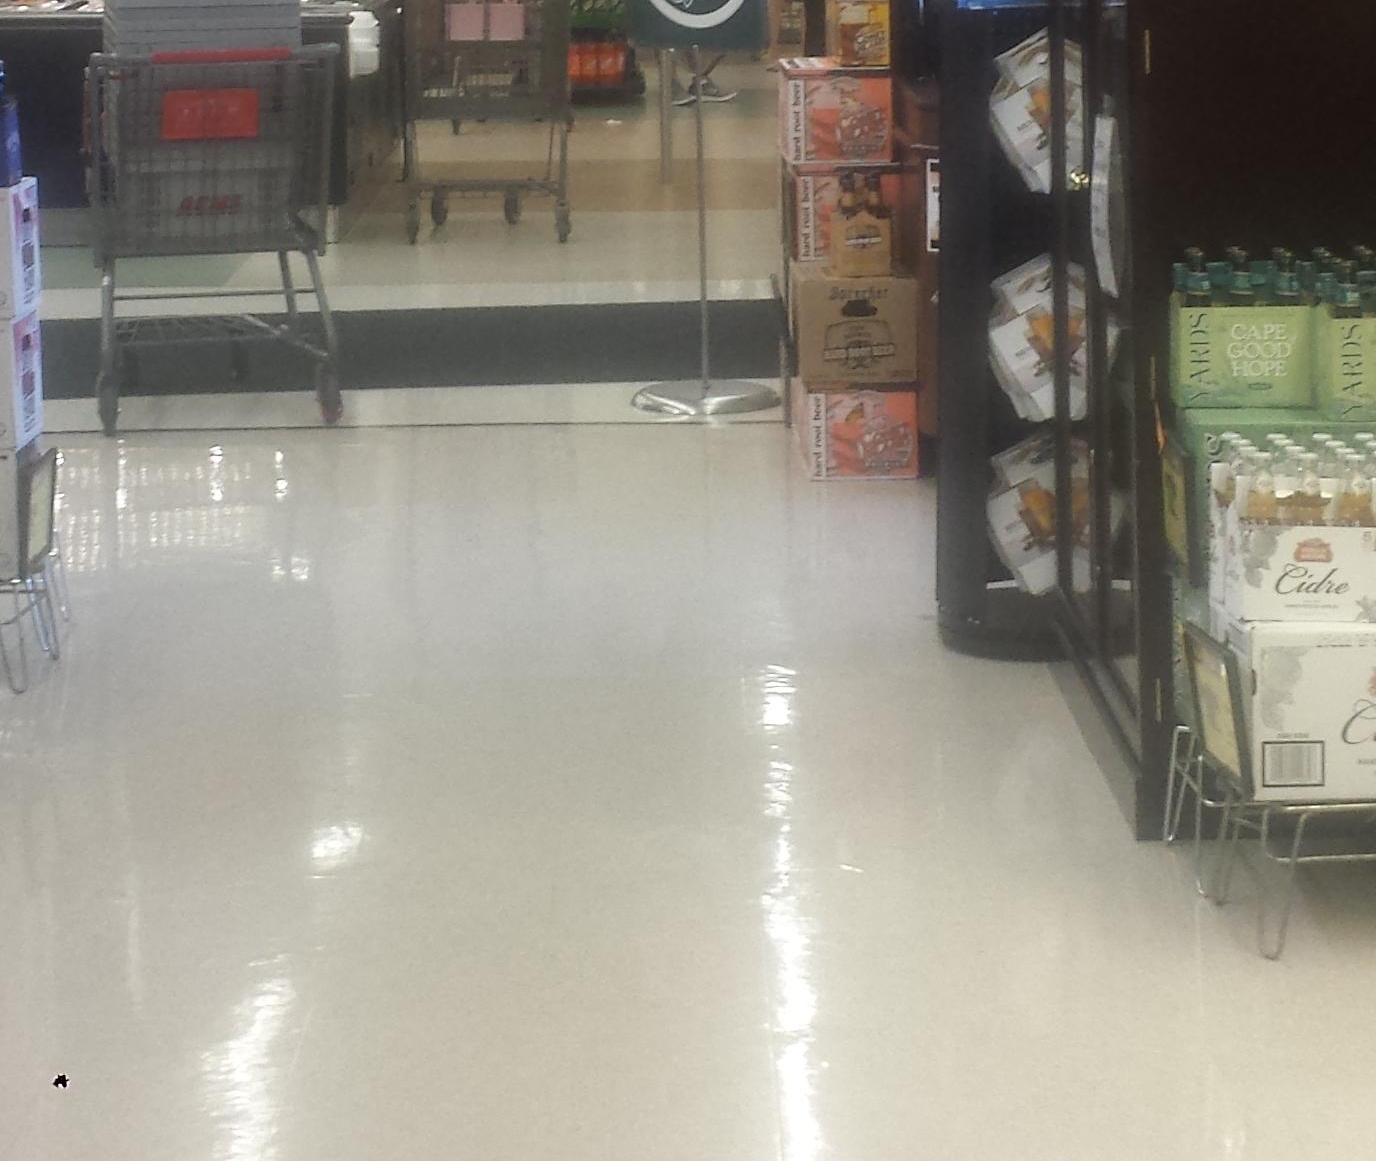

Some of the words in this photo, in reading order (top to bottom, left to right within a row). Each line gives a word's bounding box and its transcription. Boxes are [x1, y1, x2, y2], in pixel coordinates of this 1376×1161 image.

[792, 82, 801, 107] beer
[792, 111, 801, 133] root
[792, 136, 801, 162] hard
[801, 207, 811, 229] root
[801, 233, 811, 258] hard
[1231, 323, 1289, 341] CAPE
[1188, 313, 1210, 402] YARDS
[1227, 342, 1292, 360] GOOD
[1231, 360, 1289, 378] HOPE
[1340, 323, 1363, 417] YARDS
[813, 395, 822, 421] beer
[813, 425, 822, 448] root
[813, 451, 822, 477] hard
[1275, 564, 1350, 595] Cidre
